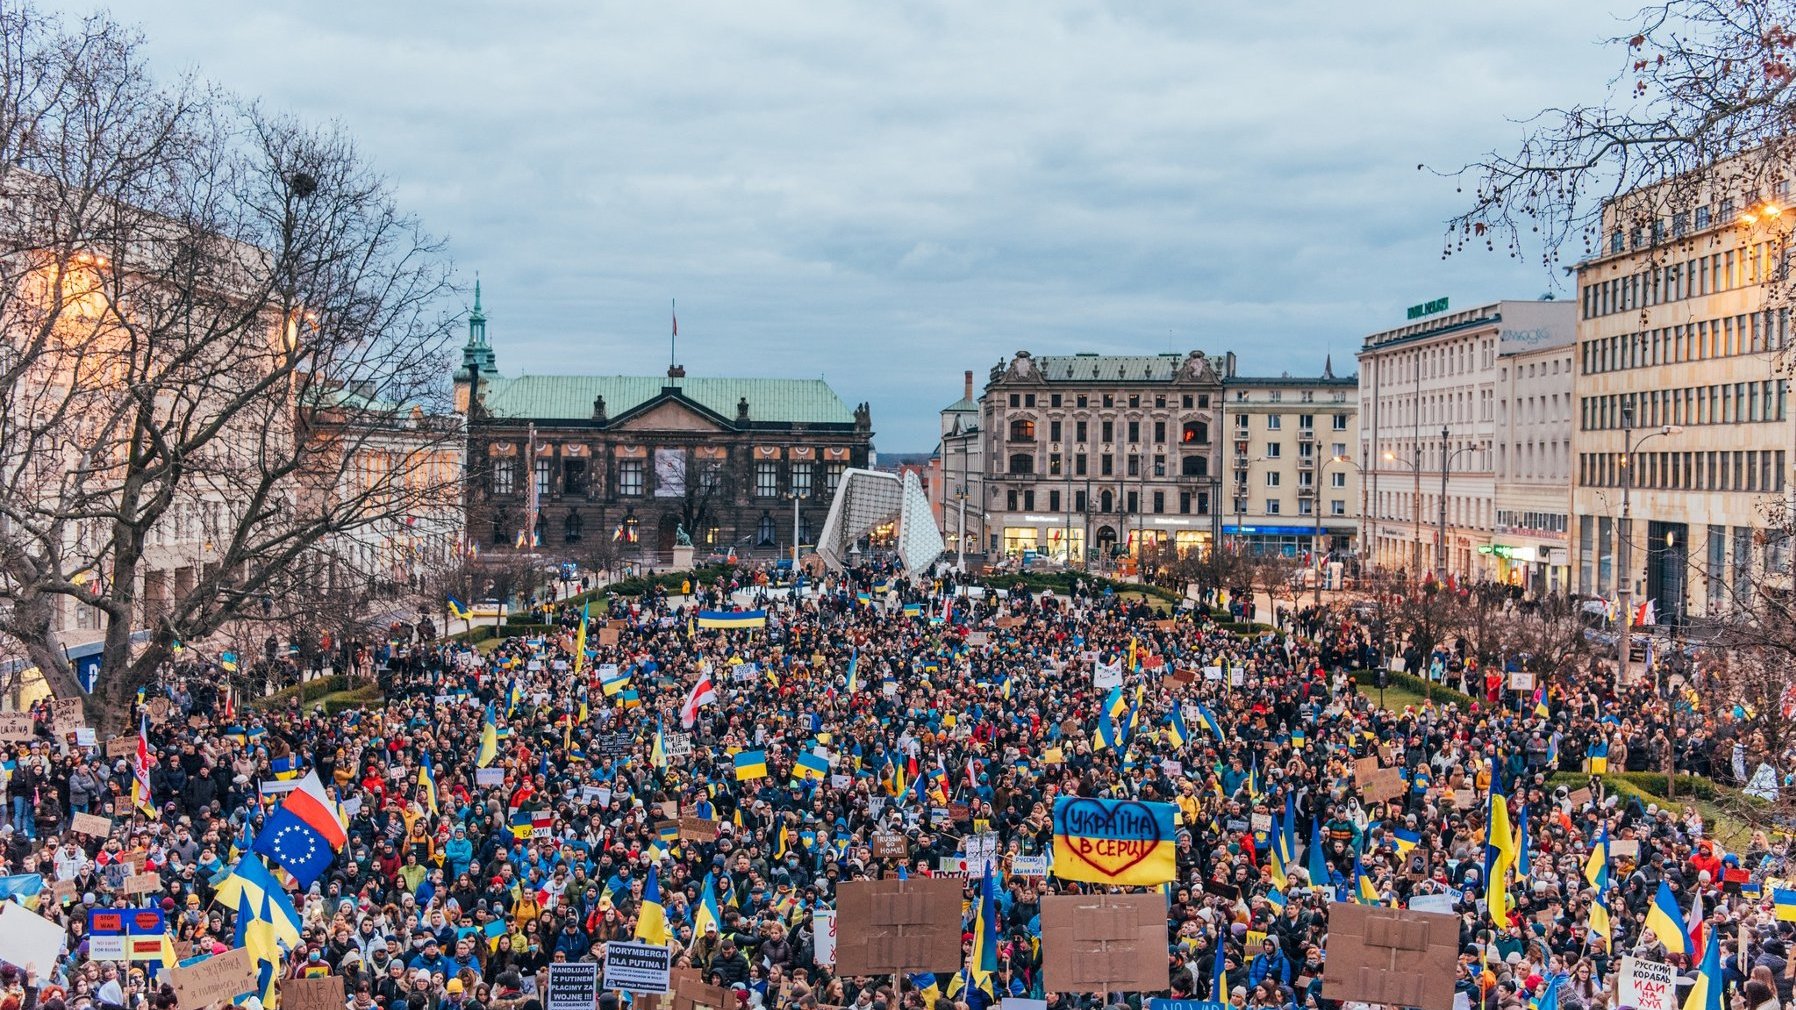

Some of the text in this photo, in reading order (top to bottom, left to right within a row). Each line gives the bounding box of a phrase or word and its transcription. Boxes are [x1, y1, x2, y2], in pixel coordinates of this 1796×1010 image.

[1070, 808, 1152, 836] УКРАЇНА
[1080, 837, 1093, 854] В
[609, 946, 668, 958] NORYMBERGA
[611, 957, 627, 966] DLA
[629, 958, 660, 969] PUTINA
[1635, 960, 1671, 976] РУССКИЙ
[1634, 980, 1666, 995] ИДИ
[1642, 991, 1657, 1000] НА
